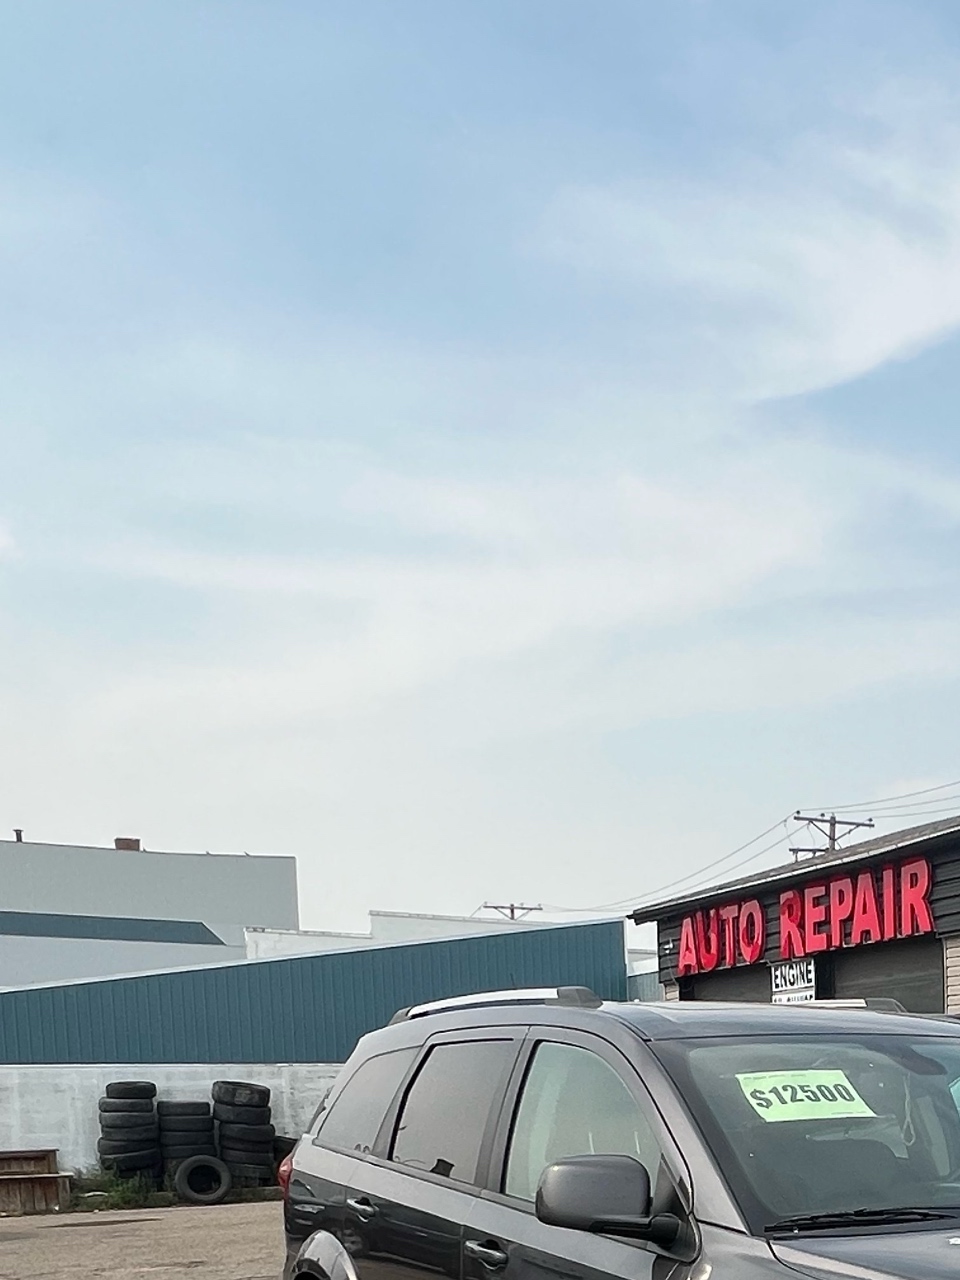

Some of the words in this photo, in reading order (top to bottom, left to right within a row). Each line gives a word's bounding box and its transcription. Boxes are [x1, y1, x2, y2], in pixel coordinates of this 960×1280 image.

[678, 899, 764, 976] AUTO
[779, 859, 935, 958] REPAIR
[774, 960, 813, 989] ENGINE
[750, 1083, 856, 1109] $12500
